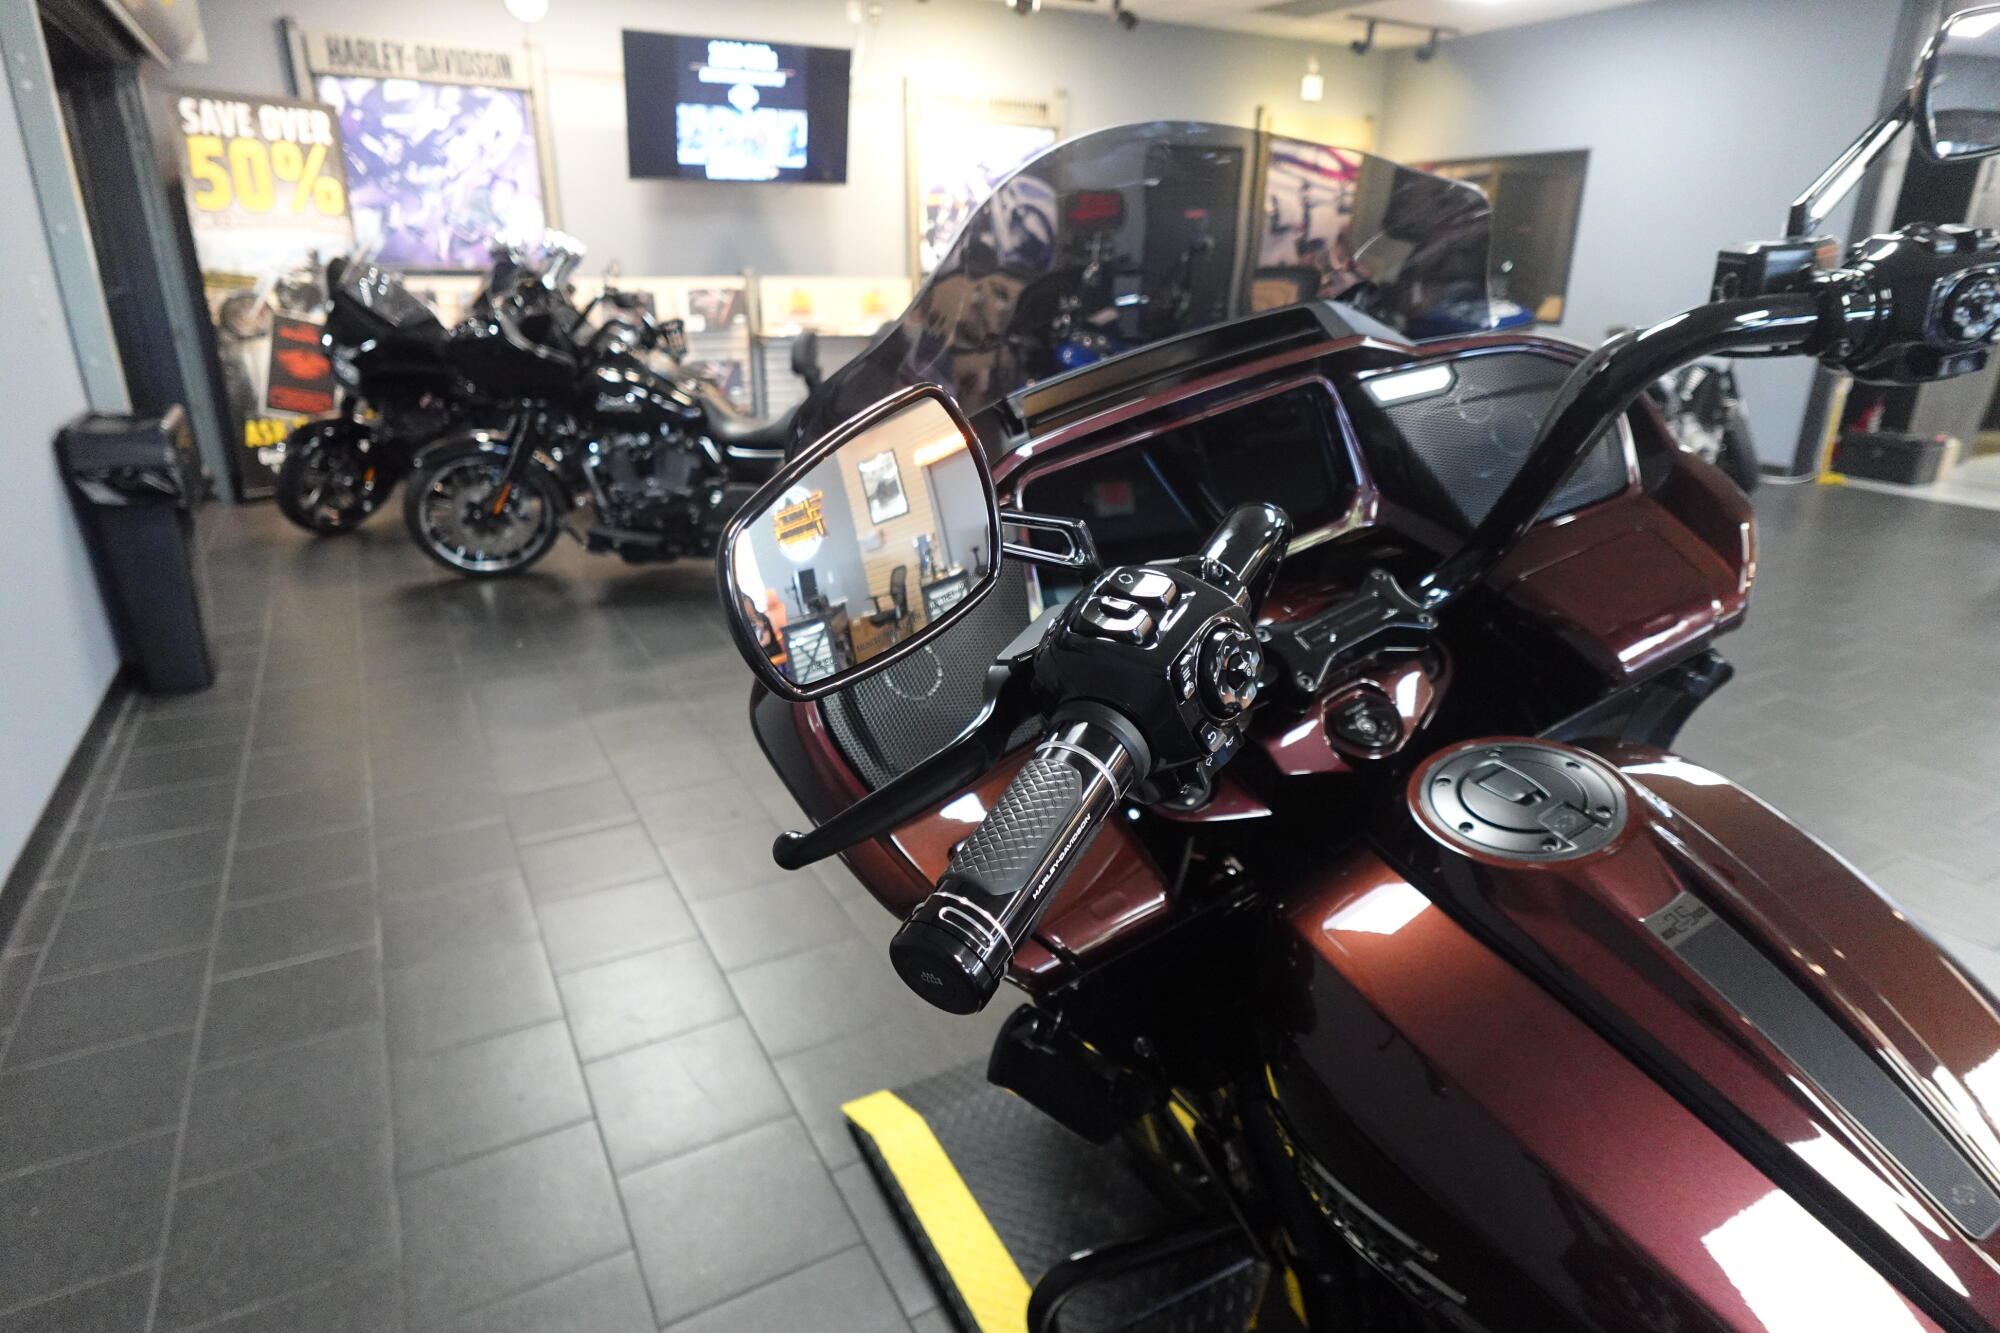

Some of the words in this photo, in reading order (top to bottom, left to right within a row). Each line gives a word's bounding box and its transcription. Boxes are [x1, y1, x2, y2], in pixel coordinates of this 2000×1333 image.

[179, 97, 255, 139] SAVE
[259, 104, 334, 146] OVER
[185, 135, 344, 216] 50%
[1032, 813, 1091, 900] HARLEY-DAVIDSON
